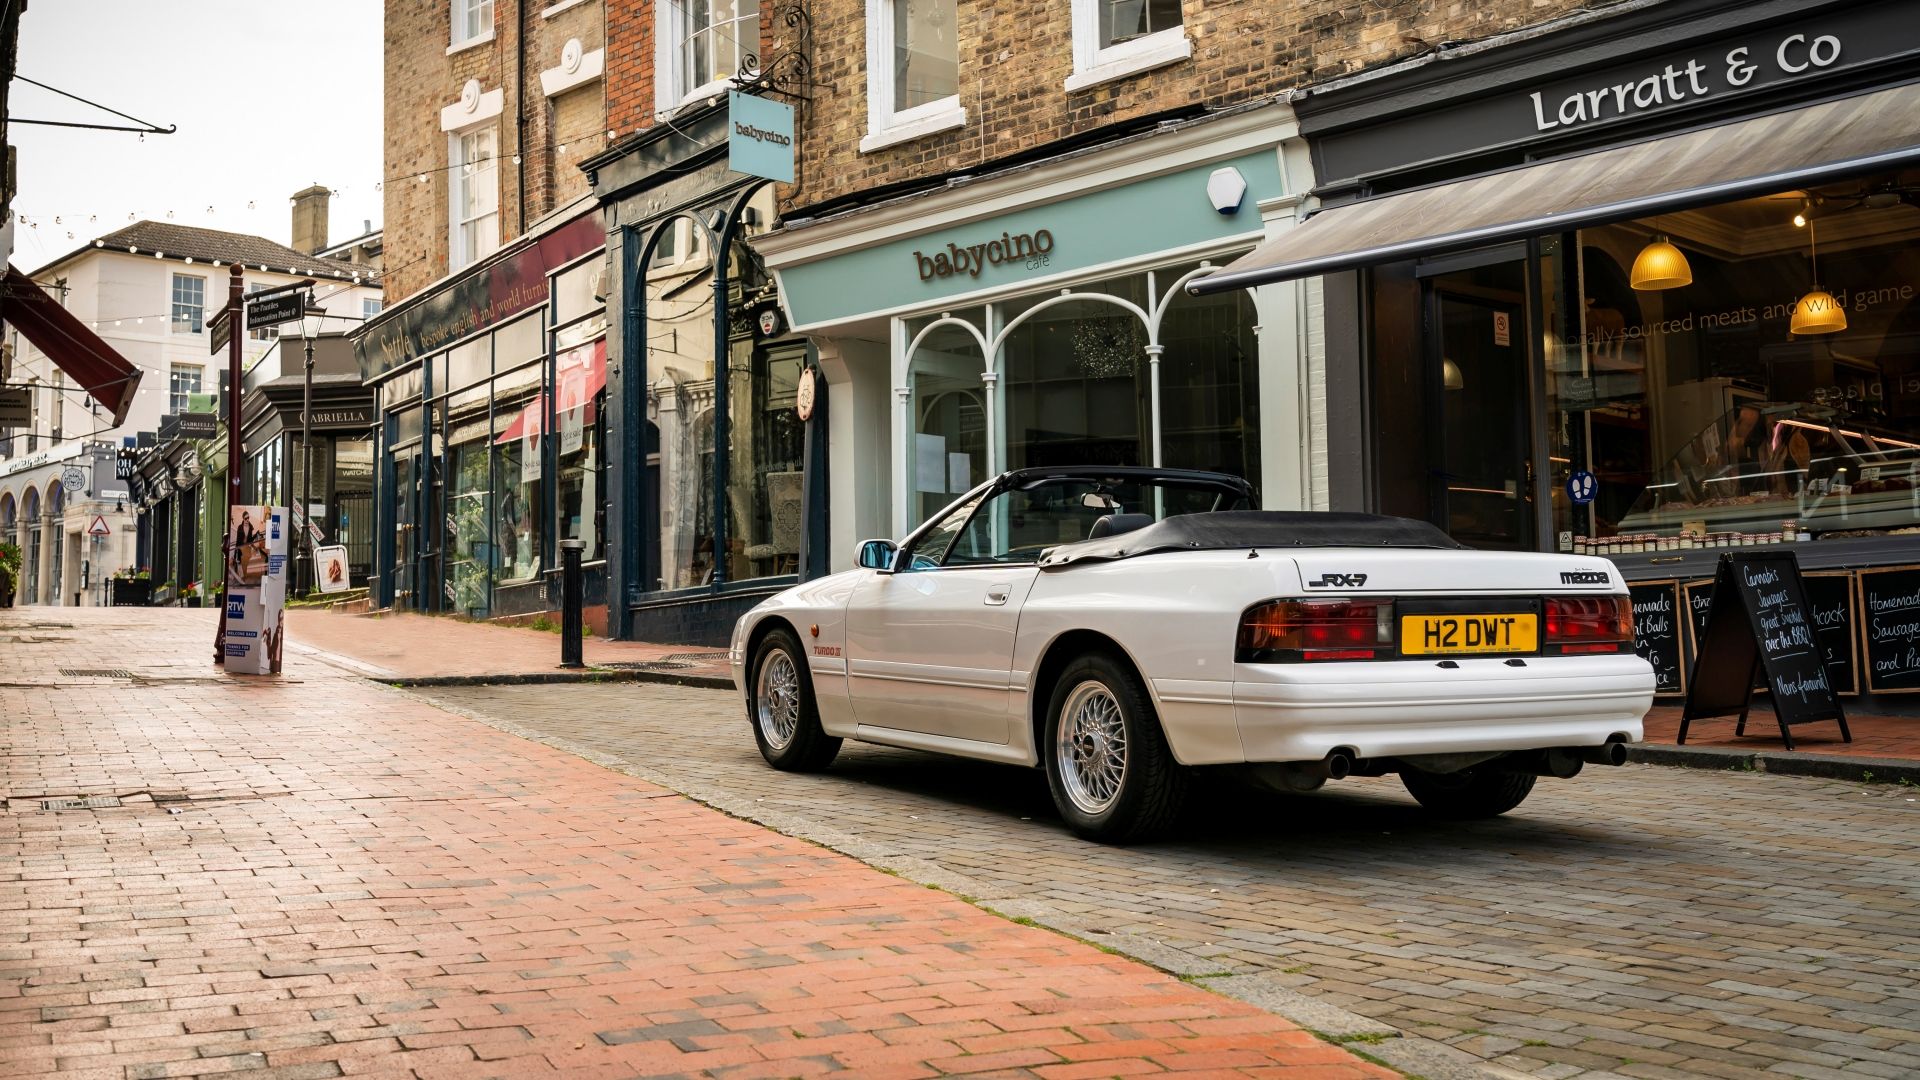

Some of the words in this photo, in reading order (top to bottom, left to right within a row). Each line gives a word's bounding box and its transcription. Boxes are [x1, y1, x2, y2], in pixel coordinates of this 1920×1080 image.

[1530, 59, 1708, 130] Larratt
[1725, 46, 1758, 86] &
[1776, 34, 1841, 73] Co
[735, 121, 791, 146] babycino
[912, 229, 1055, 281] babycino
[249, 312, 277, 325] Information
[278, 309, 291, 319] Point
[250, 305, 260, 313] The
[1567, 325, 1615, 346] ocally
[1622, 312, 1693, 339] sourced
[1701, 306, 1757, 329] meats
[1763, 296, 1798, 320] and
[1855, 285, 1913, 312] game
[380, 324, 410, 364] Settle
[420, 326, 449, 349] bespoke
[450, 308, 478, 336] english
[480, 304, 495, 323] and
[497, 291, 520, 313] world
[180, 420, 216, 428] GABRIELLA
[117, 459, 131, 468] OH
[118, 468, 131, 477] MY
[1743, 565, 1779, 587] Cannabis
[227, 602, 244, 612] RTW
[1633, 593, 1671, 614] emade
[1757, 589, 1789, 612] Sausages
[1870, 588, 1920, 611] Homemad
[1424, 619, 1458, 648] H2
[1465, 618, 1515, 647] DWT
[1646, 615, 1668, 633] Balls
[1872, 618, 1920, 643] Sausage
[814, 646, 835, 656] TURBO
[1876, 653, 1900, 671] and
